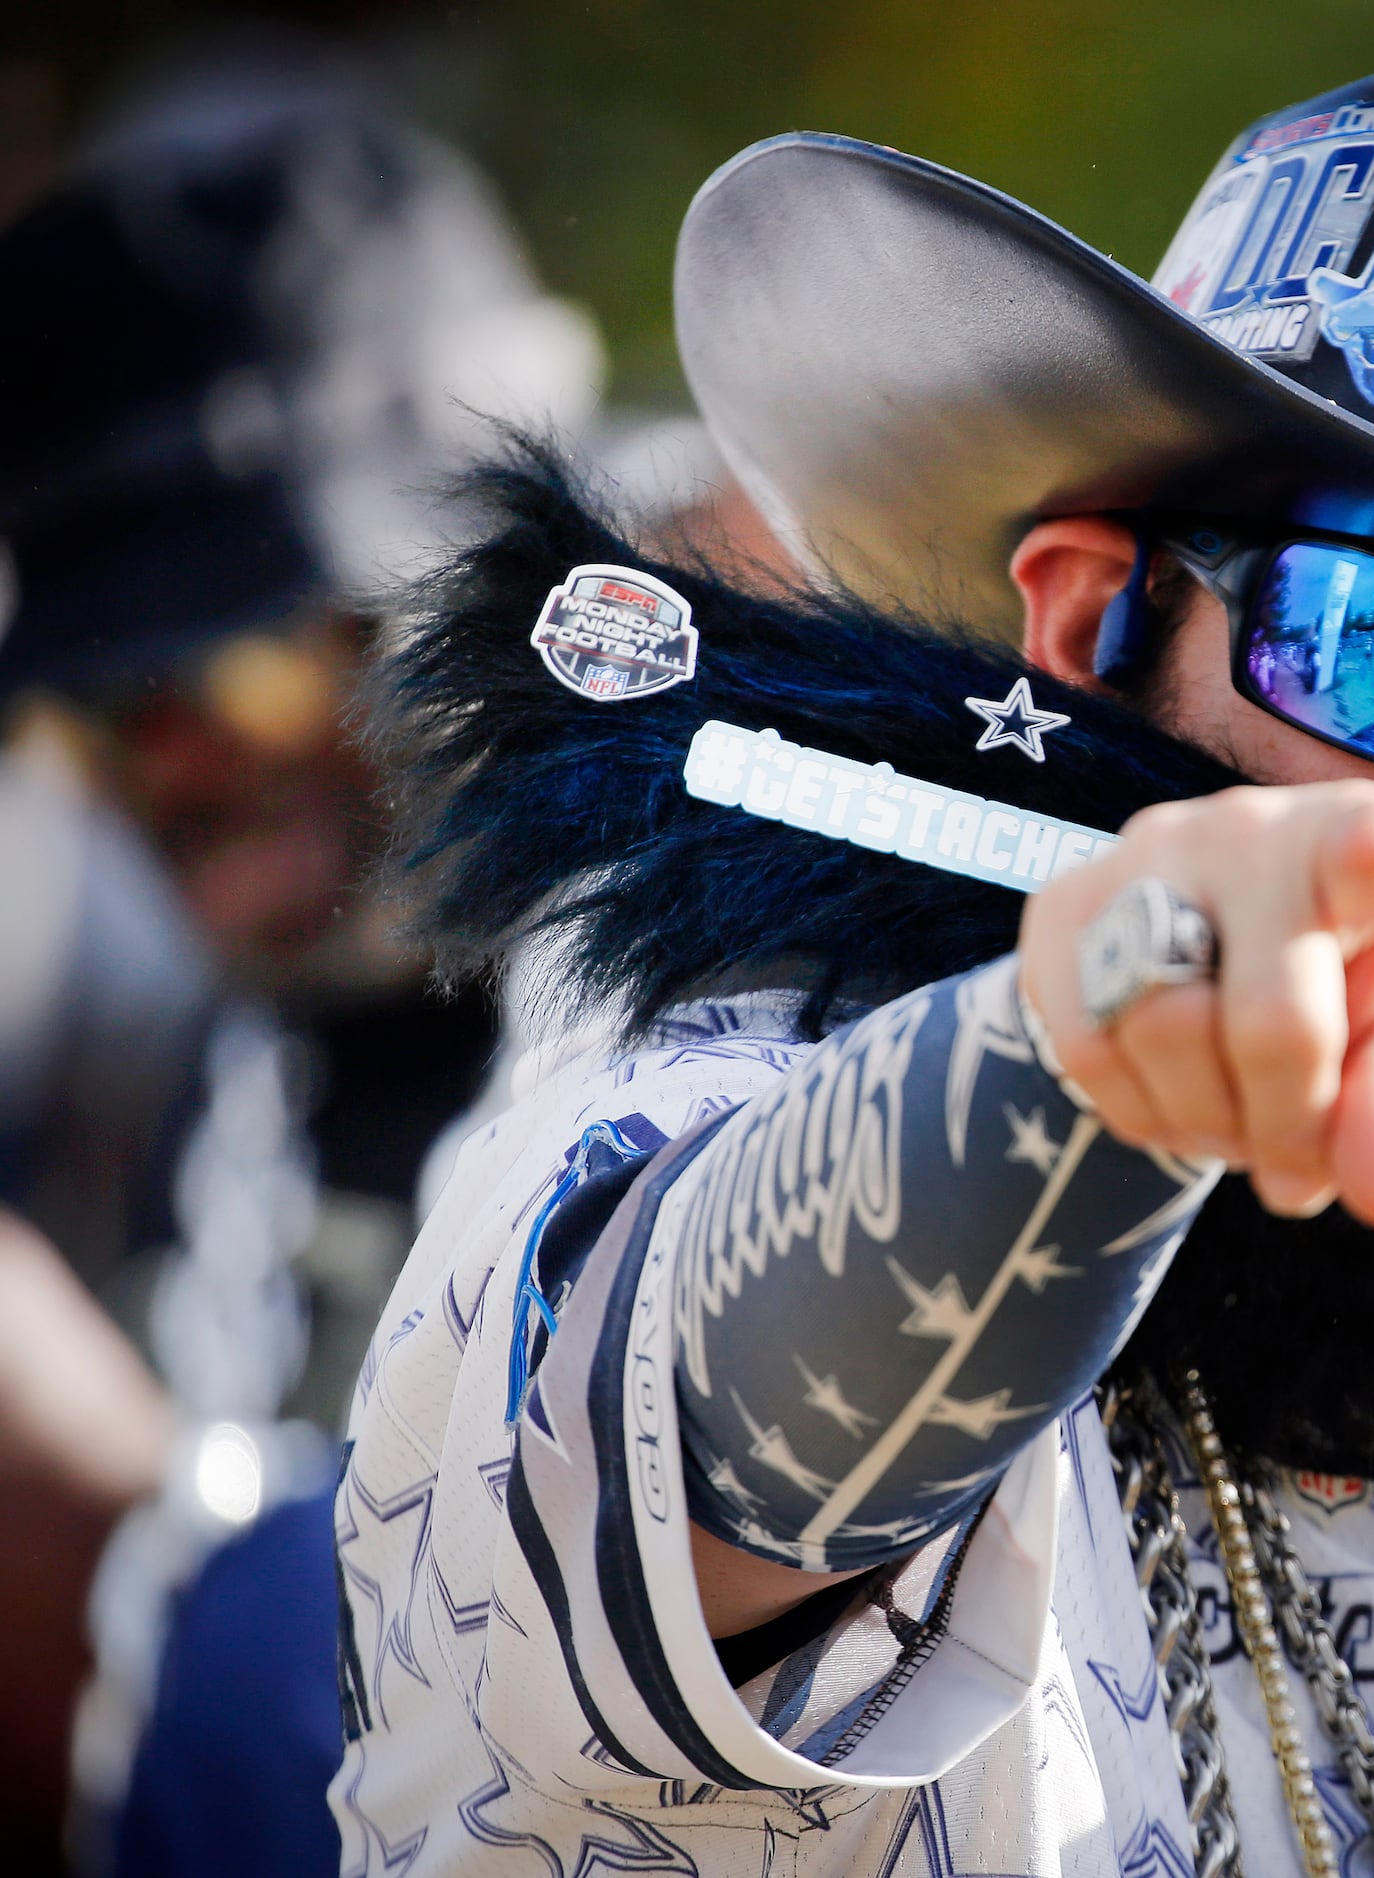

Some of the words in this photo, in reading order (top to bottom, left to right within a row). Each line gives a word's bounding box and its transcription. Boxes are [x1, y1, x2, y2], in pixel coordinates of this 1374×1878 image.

[599, 582, 658, 614] ESPN
[559, 596, 682, 642] MONDAY
[572, 614, 664, 649] NIGHT
[540, 622, 687, 672] FOOTBALL
[587, 678, 620, 694] NFL
[695, 732, 1126, 882] #GETSTACHE
